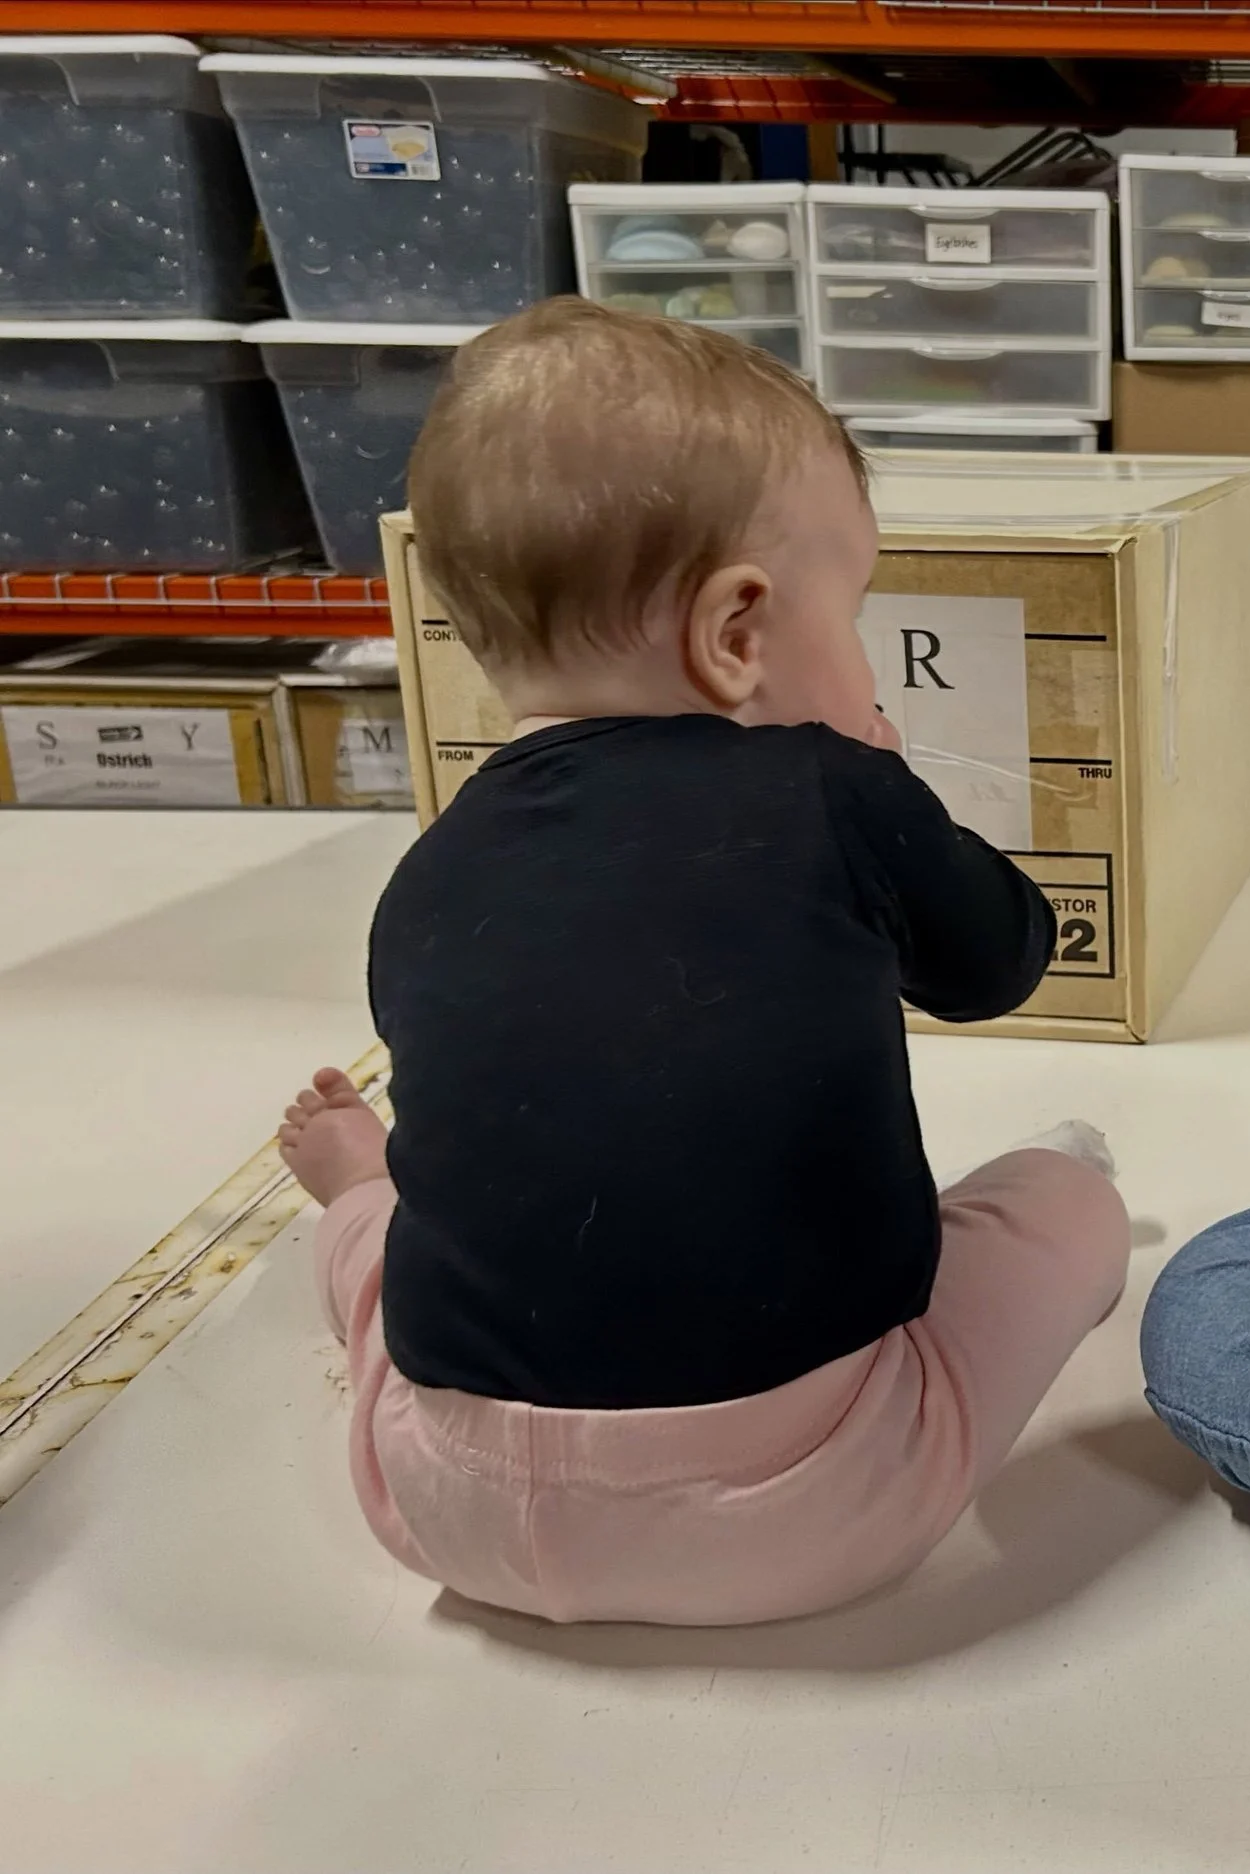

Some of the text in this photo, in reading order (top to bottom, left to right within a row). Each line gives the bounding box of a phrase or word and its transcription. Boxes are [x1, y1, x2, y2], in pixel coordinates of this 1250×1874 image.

[900, 629, 955, 690] R
[36, 720, 199, 751] S Y
[362, 726, 393, 753] M
[438, 750, 474, 762] FROM
[1078, 767, 1112, 779] THRU
[1048, 898, 1097, 913] STOR
[1050, 918, 1098, 962] 2
